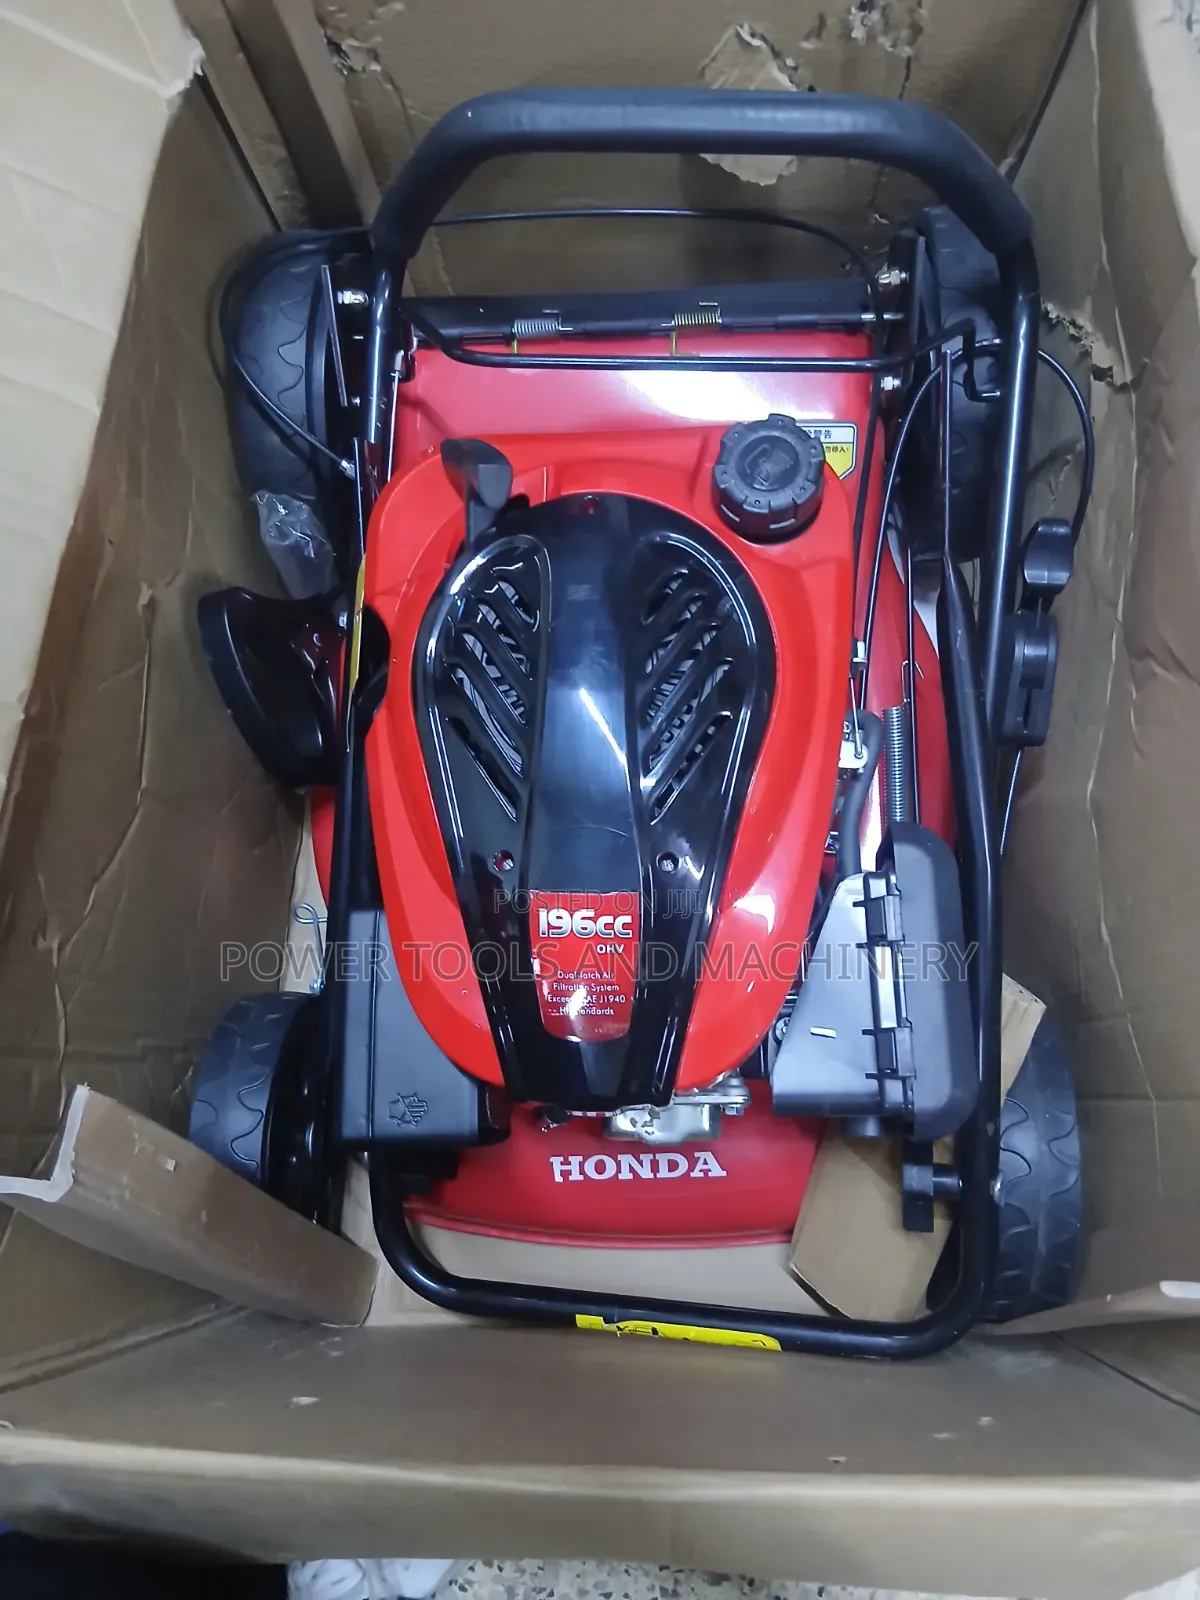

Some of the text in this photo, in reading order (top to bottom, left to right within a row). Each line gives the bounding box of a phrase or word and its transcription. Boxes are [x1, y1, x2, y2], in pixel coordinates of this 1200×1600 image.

[538, 908, 632, 938] 196cc
[597, 944, 624, 954] OHV
[553, 982, 619, 992] Filtratin System
[600, 995, 625, 1003] J1940
[550, 1152, 726, 1182] HONDA
